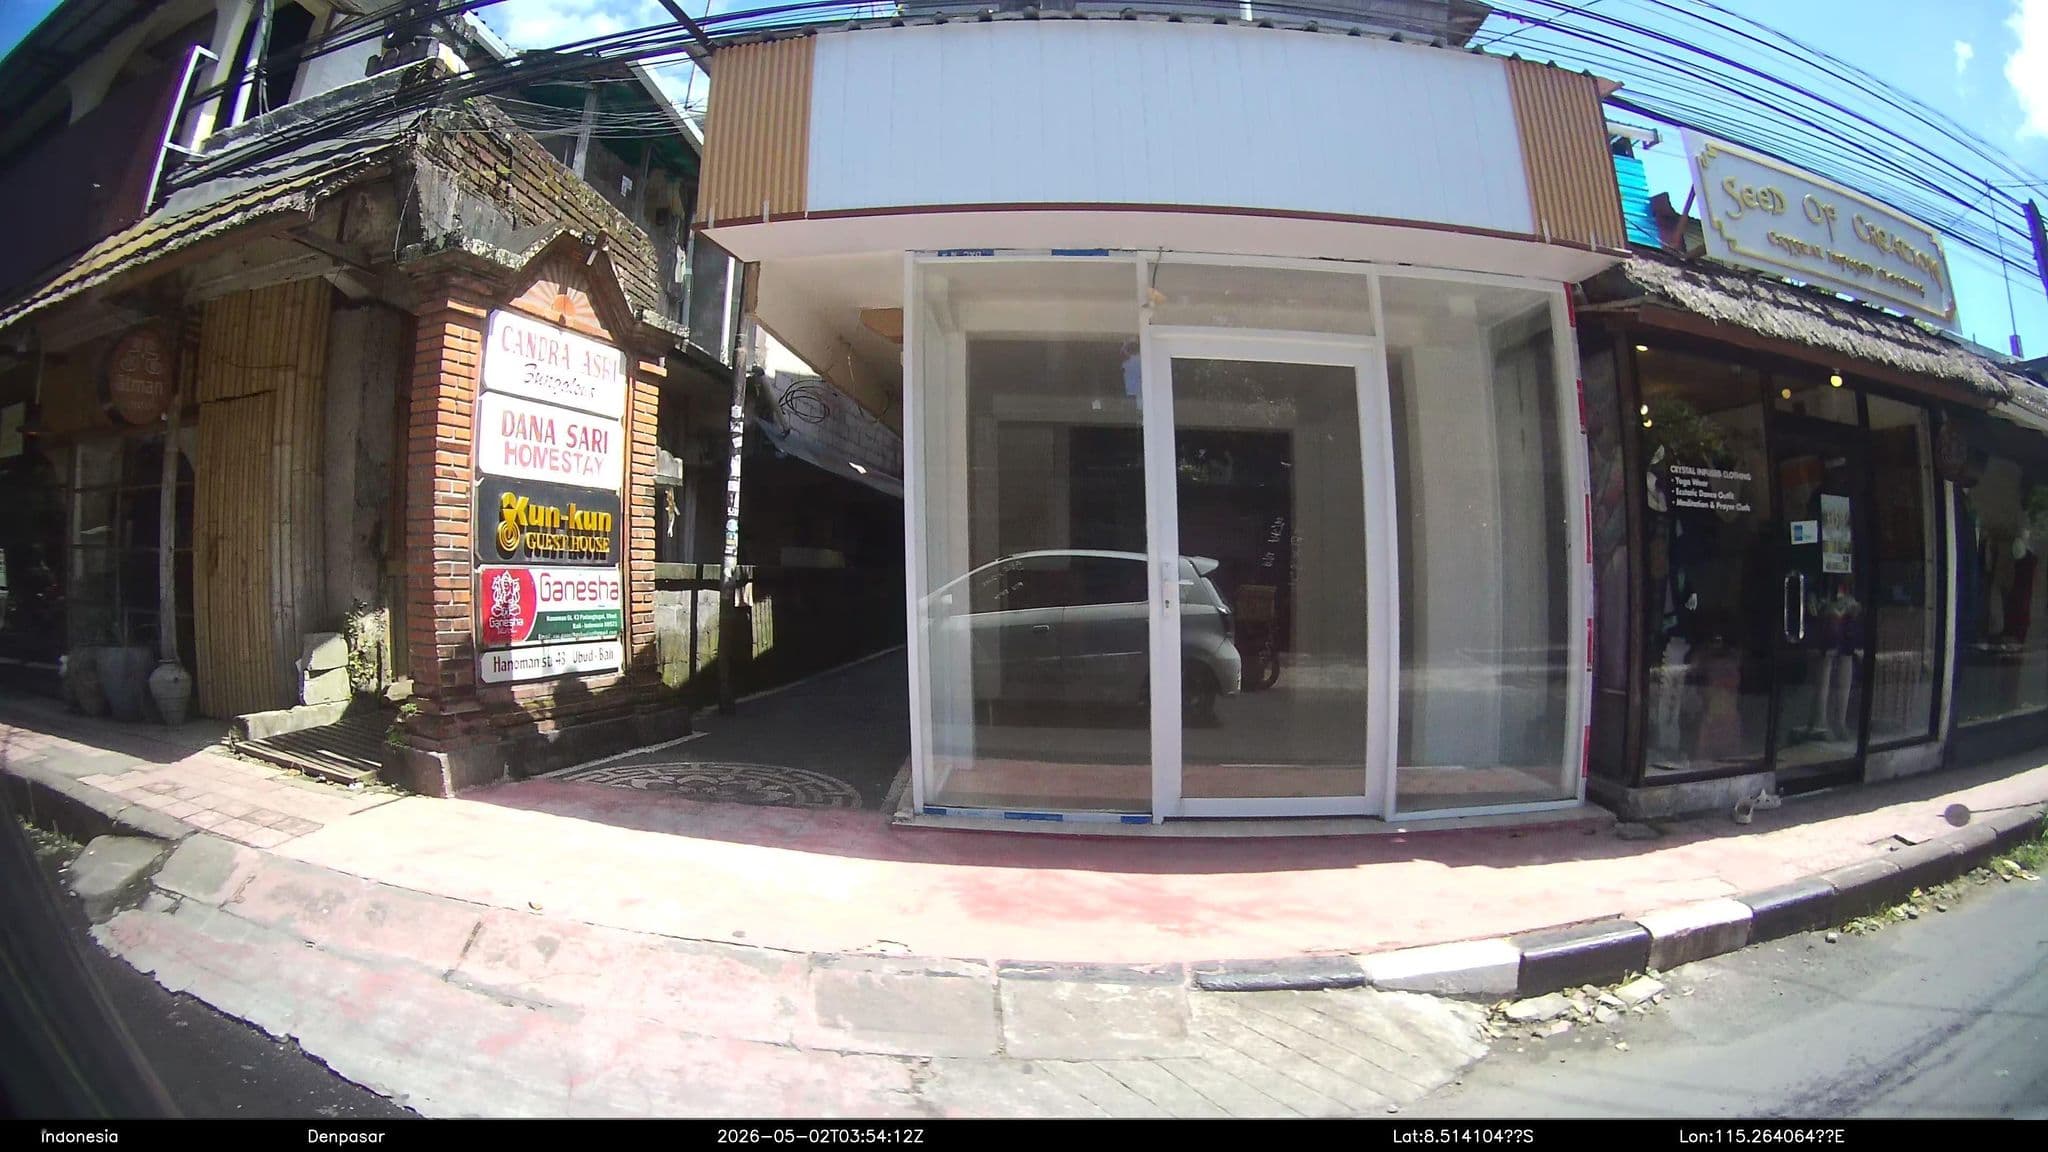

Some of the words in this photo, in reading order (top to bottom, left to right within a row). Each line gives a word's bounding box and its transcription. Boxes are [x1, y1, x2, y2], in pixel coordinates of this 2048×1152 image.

[502, 325, 570, 370] CANDRA
[502, 410, 556, 446] DANA
[566, 424, 608, 455] SARI
[504, 441, 605, 476] HOMESTAY
[1670, 465, 1696, 475] CRYSTAL
[1722, 470, 1752, 481] CLOTHING
[525, 532, 569, 551] GUEST
[571, 535, 611, 553] HOUSE
[540, 572, 619, 602] Ganesha
[493, 656, 540, 673] Hanoman
[573, 648, 594, 664] Ubud
